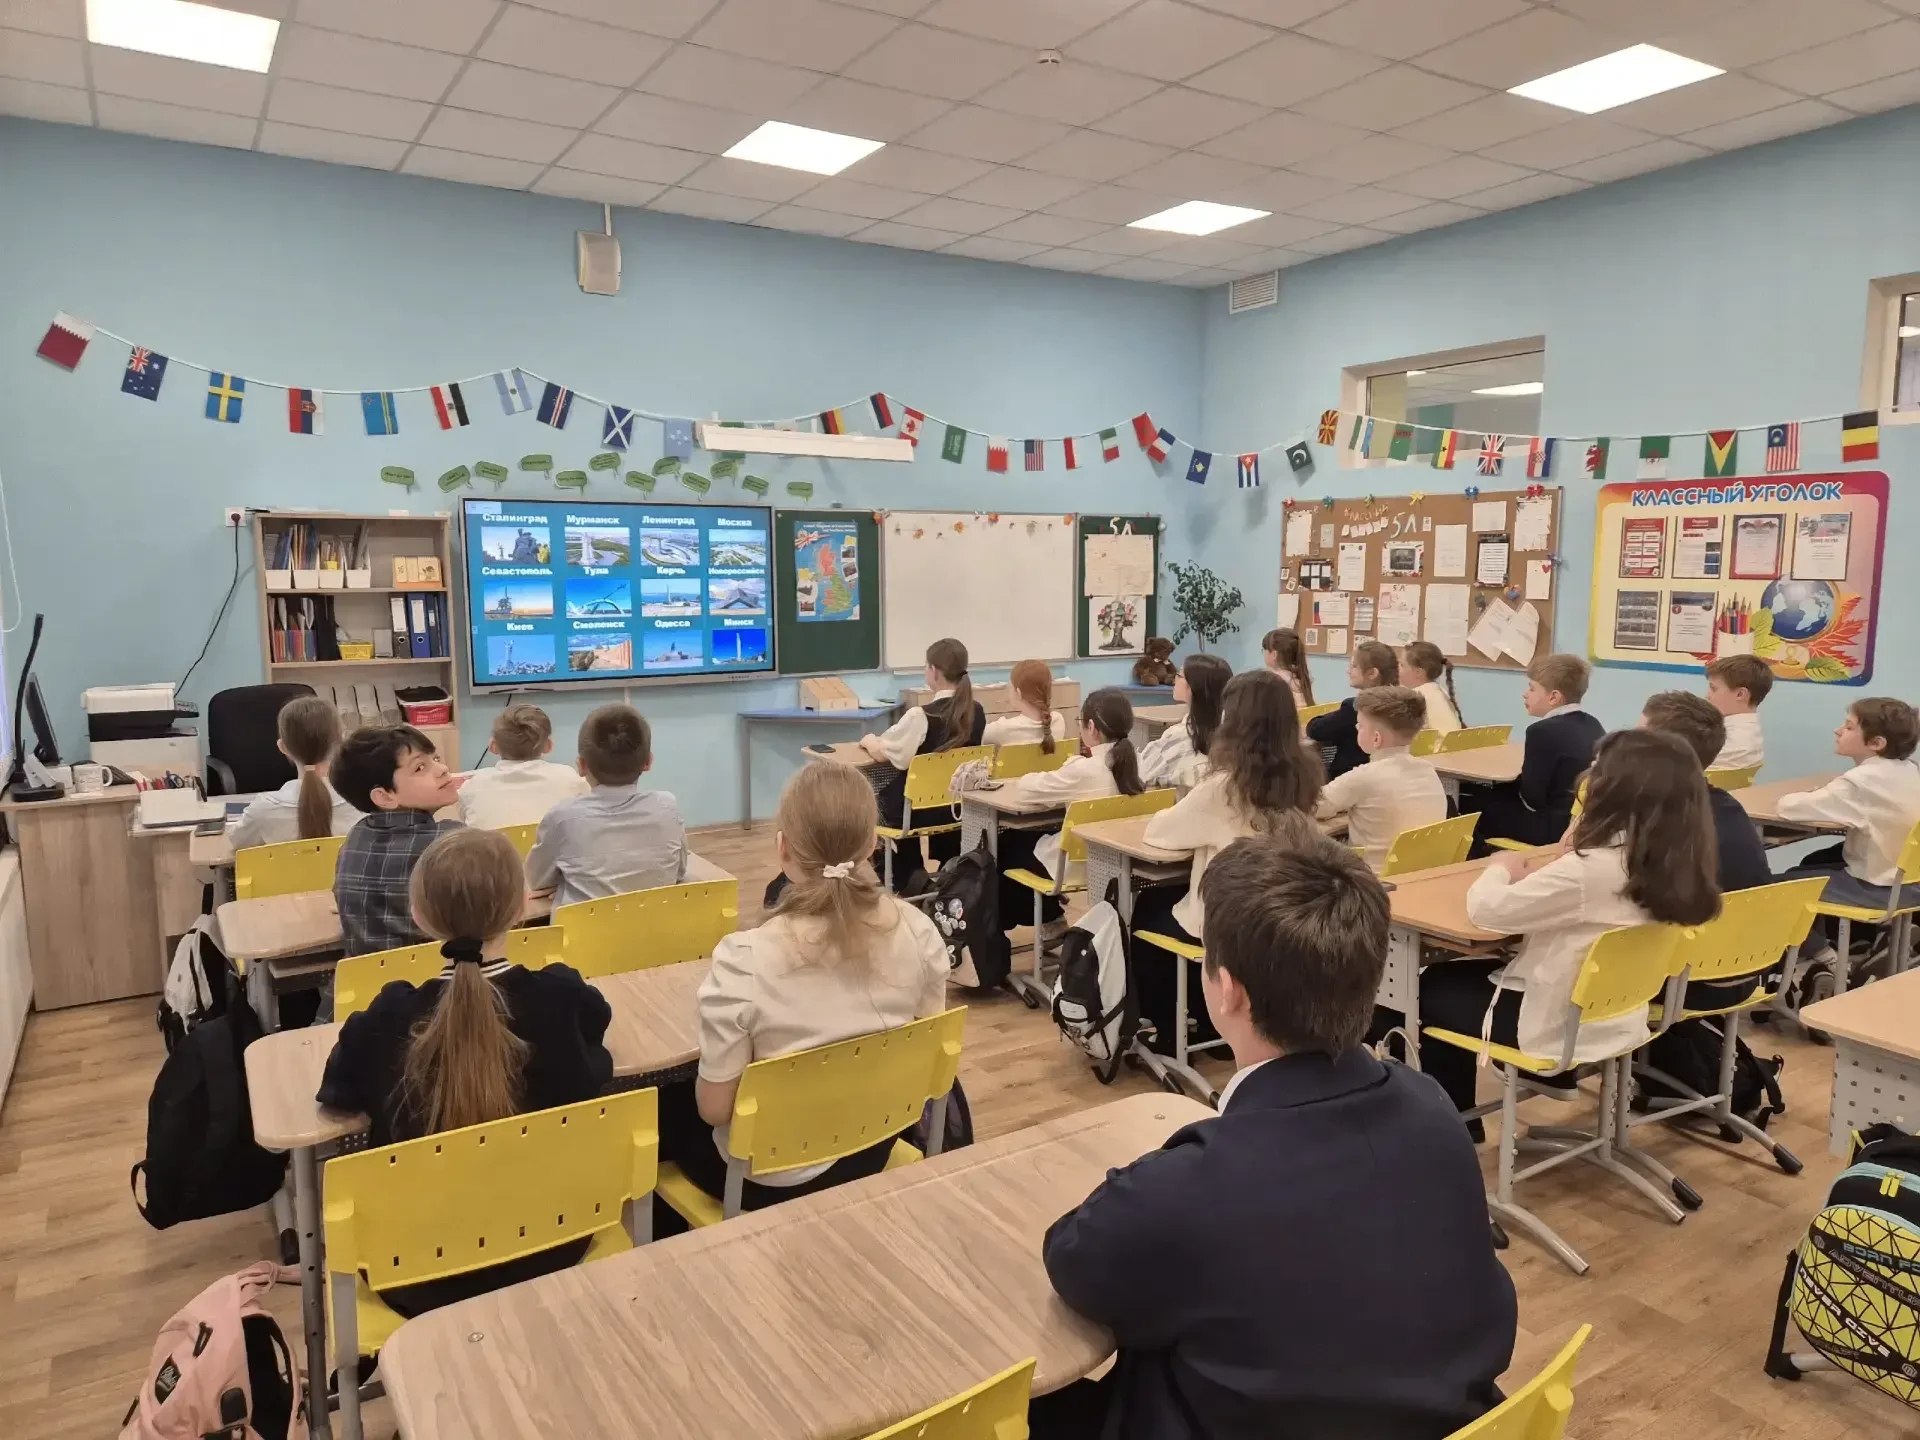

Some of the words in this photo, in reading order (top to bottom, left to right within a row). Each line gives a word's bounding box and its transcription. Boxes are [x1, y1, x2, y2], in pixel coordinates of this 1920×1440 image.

[1631, 481, 1745, 507] КЛАССНЫЙ
[1750, 481, 1844, 503] УГОЛОК
[482, 513, 549, 524] Сталинград
[566, 514, 620, 525] Мурманск
[642, 515, 696, 526] Ленинград
[717, 518, 753, 526] Москва
[482, 566, 553, 576] Севастополь
[583, 566, 609, 576] Тула
[656, 566, 686, 576] Керчь
[506, 622, 535, 631] Киев
[573, 621, 625, 630] Смоленск
[654, 619, 691, 628] Одесса
[723, 618, 755, 627] Минск
[1843, 1242, 1893, 1266] BORN
[1800, 1265, 1842, 1317] NEVER
[1845, 1317, 1891, 1358] GIVE
